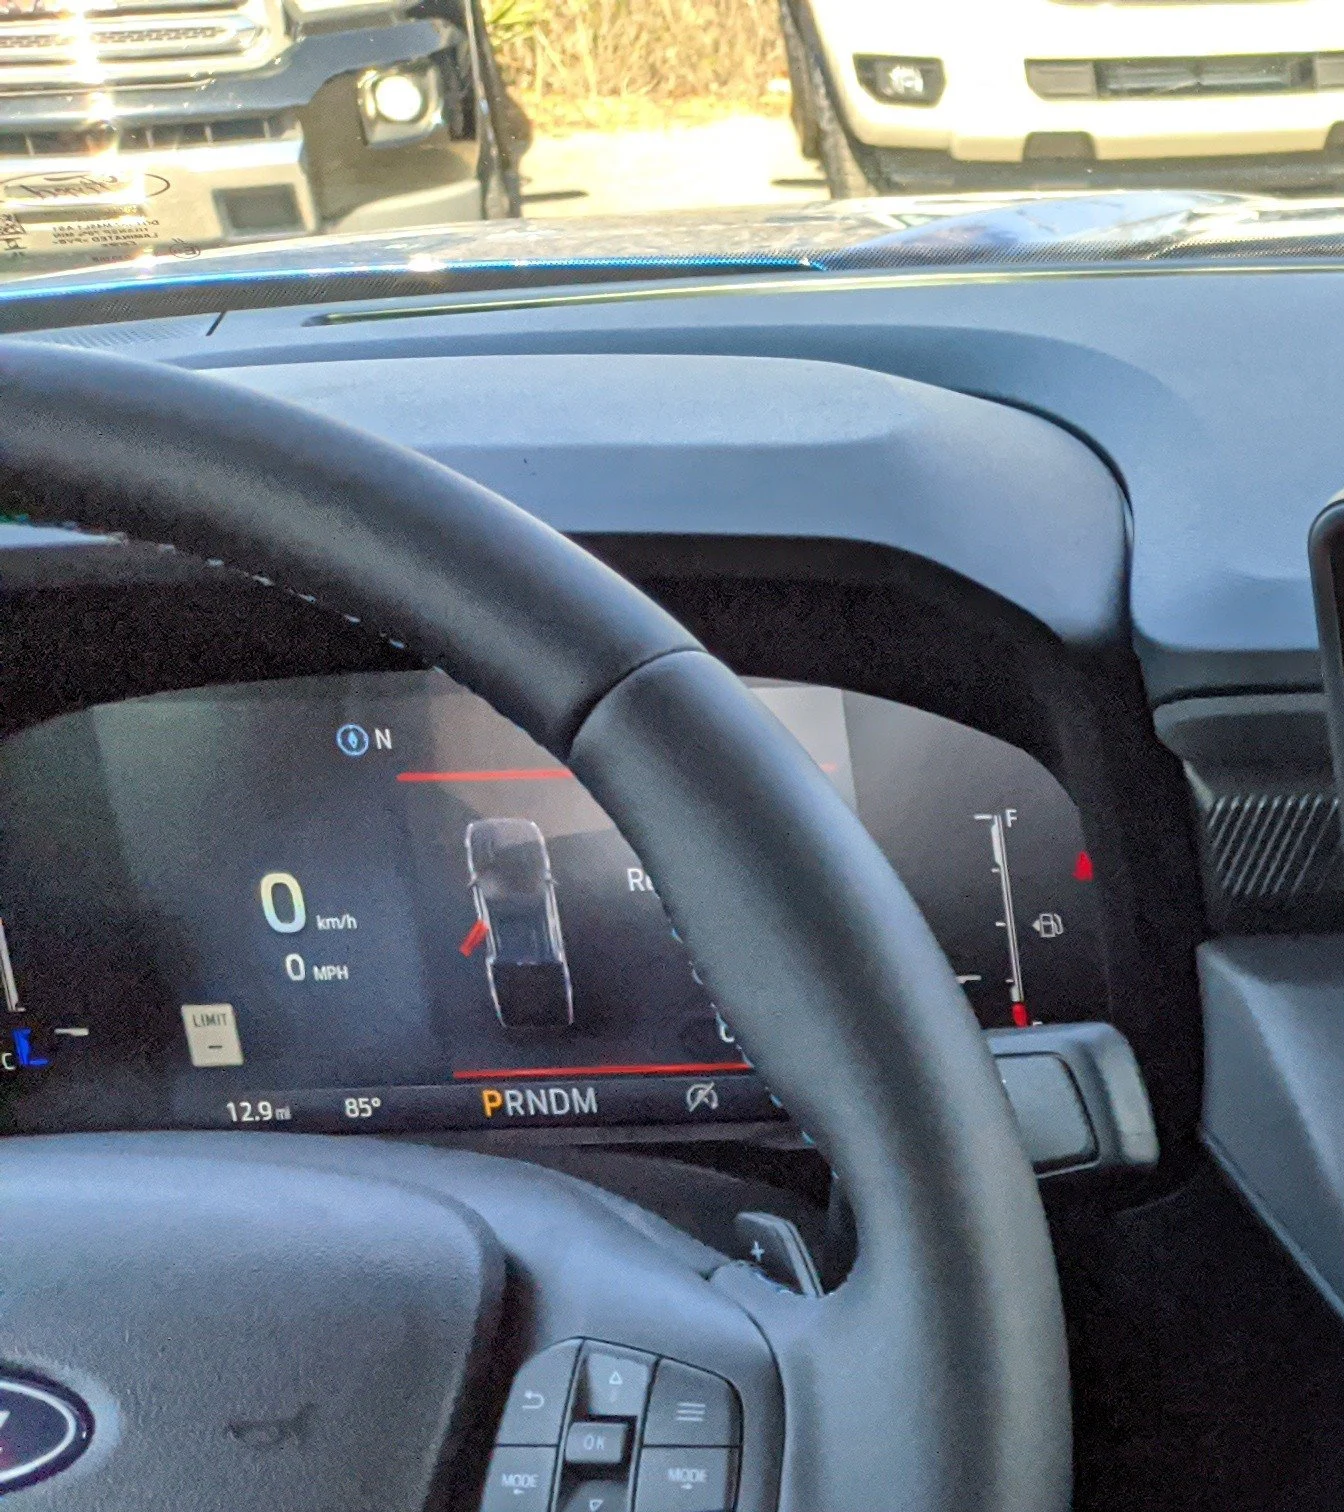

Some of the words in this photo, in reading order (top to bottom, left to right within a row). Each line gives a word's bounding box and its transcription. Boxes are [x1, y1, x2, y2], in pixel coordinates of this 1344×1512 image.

[375, 728, 393, 750] N
[1005, 808, 1018, 827] F
[260, 871, 307, 934] 0
[315, 914, 358, 931] km/h
[284, 952, 306, 982] 0
[312, 964, 350, 982] MPH
[192, 1012, 228, 1028] LIMIT
[501, 1473, 540, 1489] MODE
[667, 1468, 709, 1485] MODE
